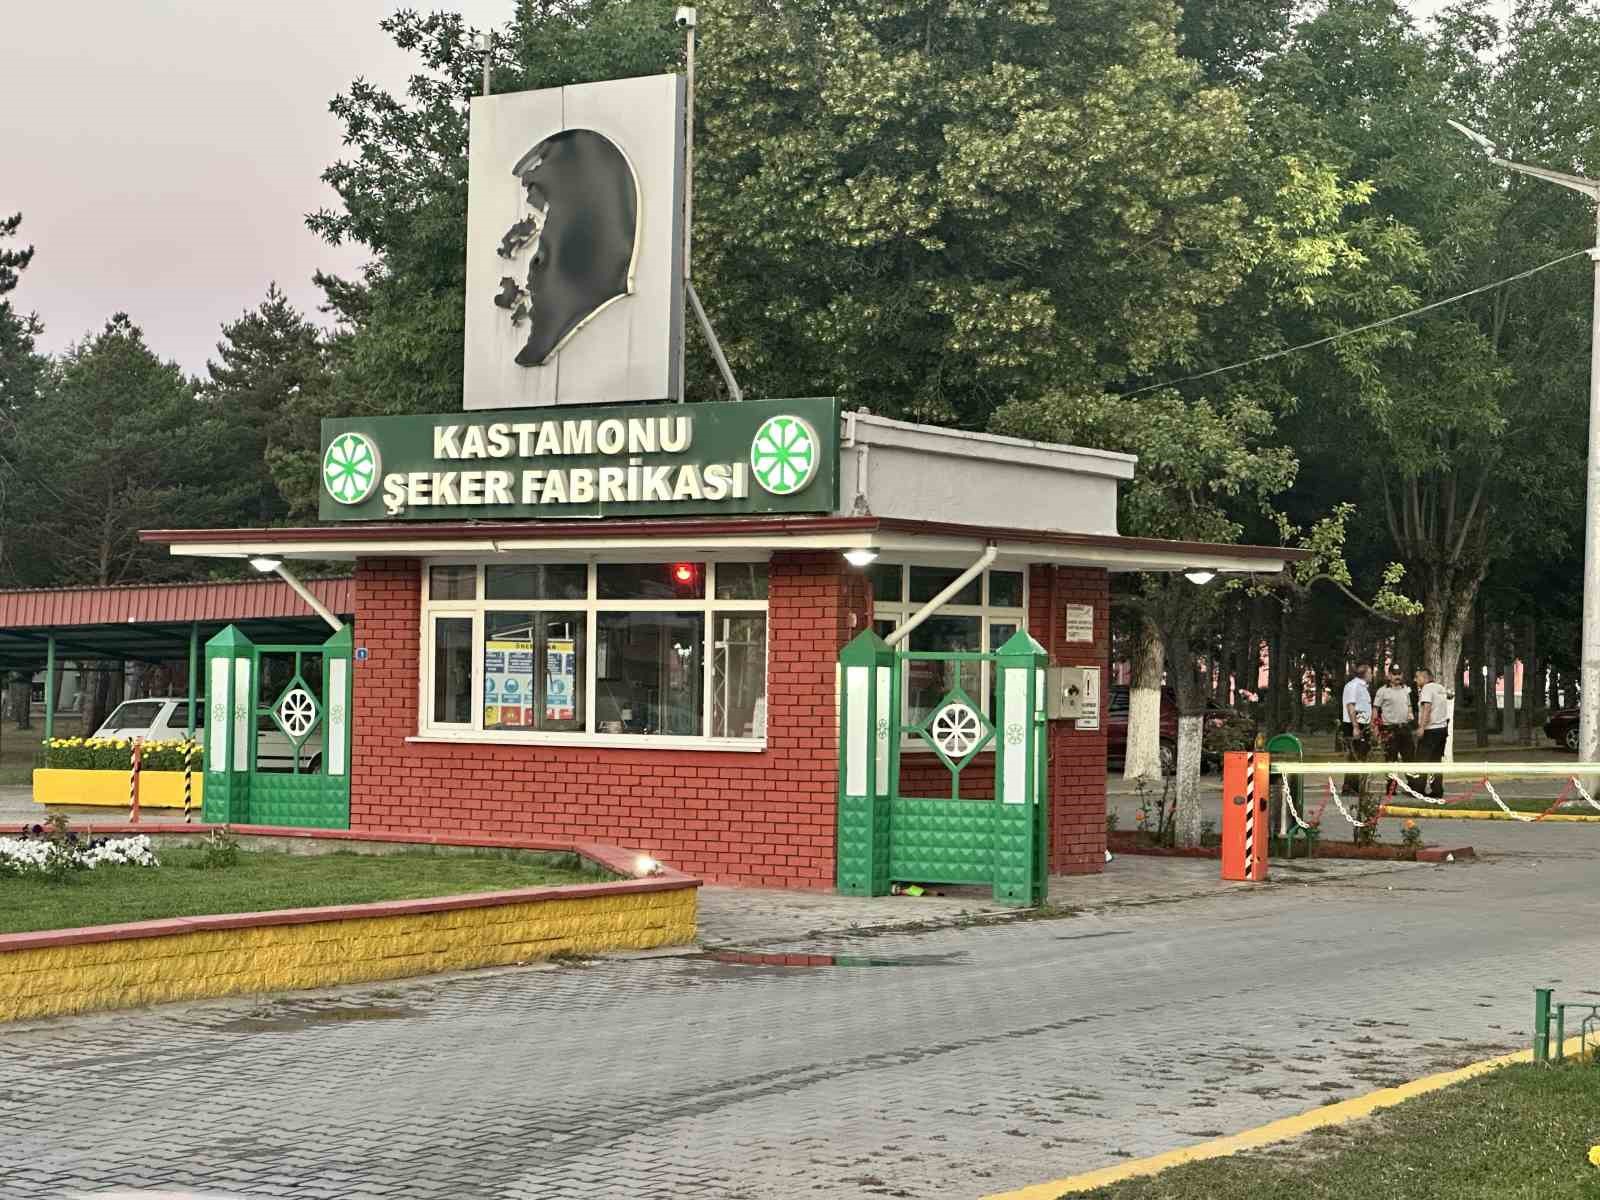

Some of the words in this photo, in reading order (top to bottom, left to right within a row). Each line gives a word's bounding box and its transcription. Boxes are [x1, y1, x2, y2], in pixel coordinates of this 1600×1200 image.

[433, 416, 692, 459] KASTAMONU
[382, 468, 514, 515] ŞEKER
[521, 457, 749, 504] FABRİKASI
